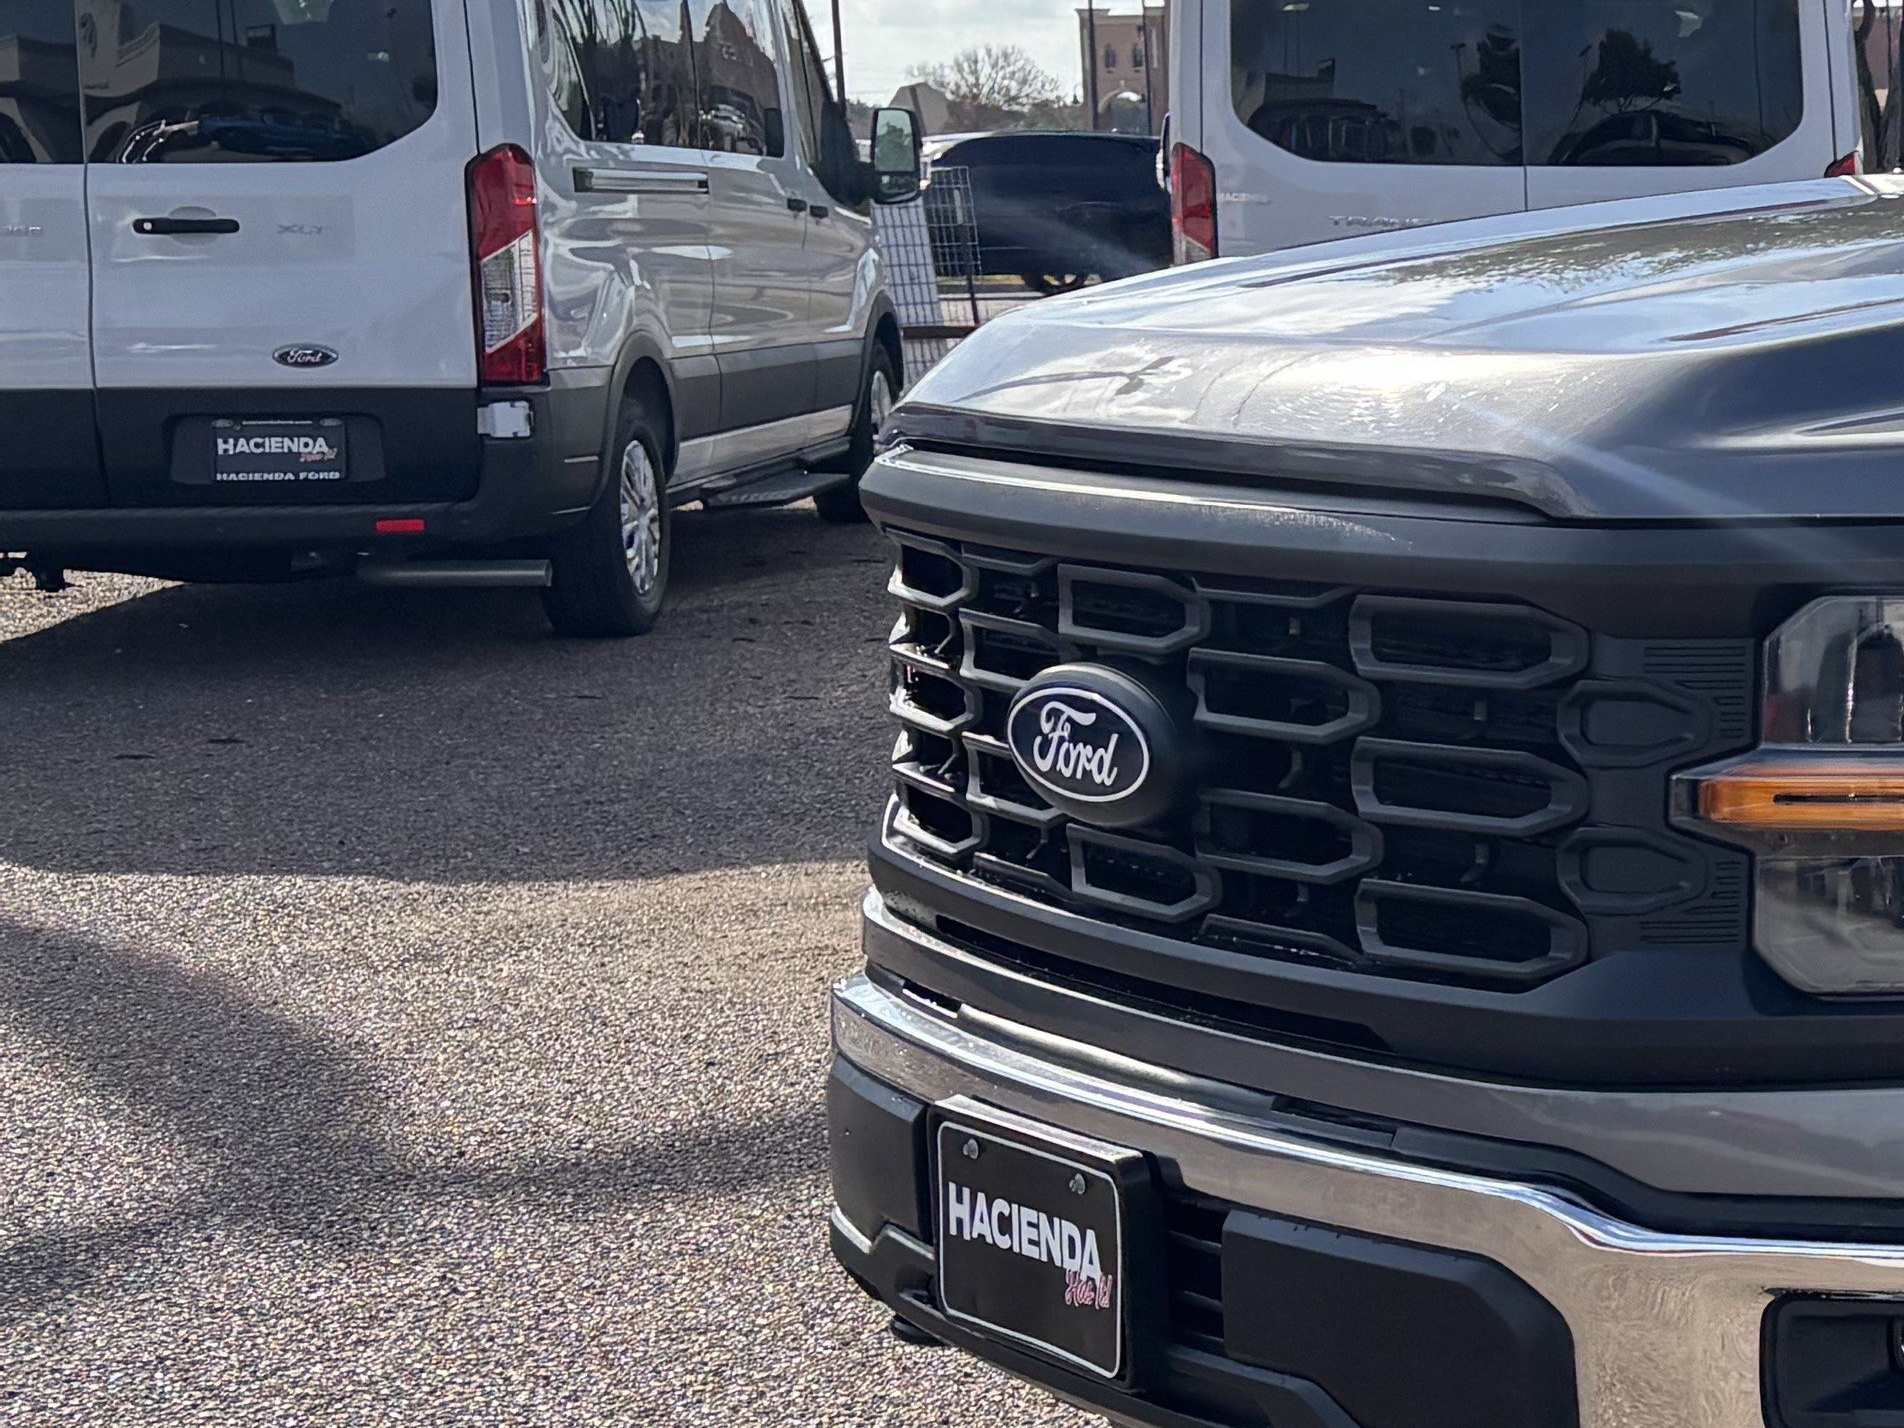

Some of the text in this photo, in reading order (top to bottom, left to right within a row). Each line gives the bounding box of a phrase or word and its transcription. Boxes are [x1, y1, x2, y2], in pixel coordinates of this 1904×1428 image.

[286, 349, 323, 364] Ford
[216, 436, 328, 455] HACIENDA
[216, 471, 340, 481] HACIENDA FORD
[1033, 701, 1119, 786] Ford
[948, 1181, 1102, 1284] HACIENDA
